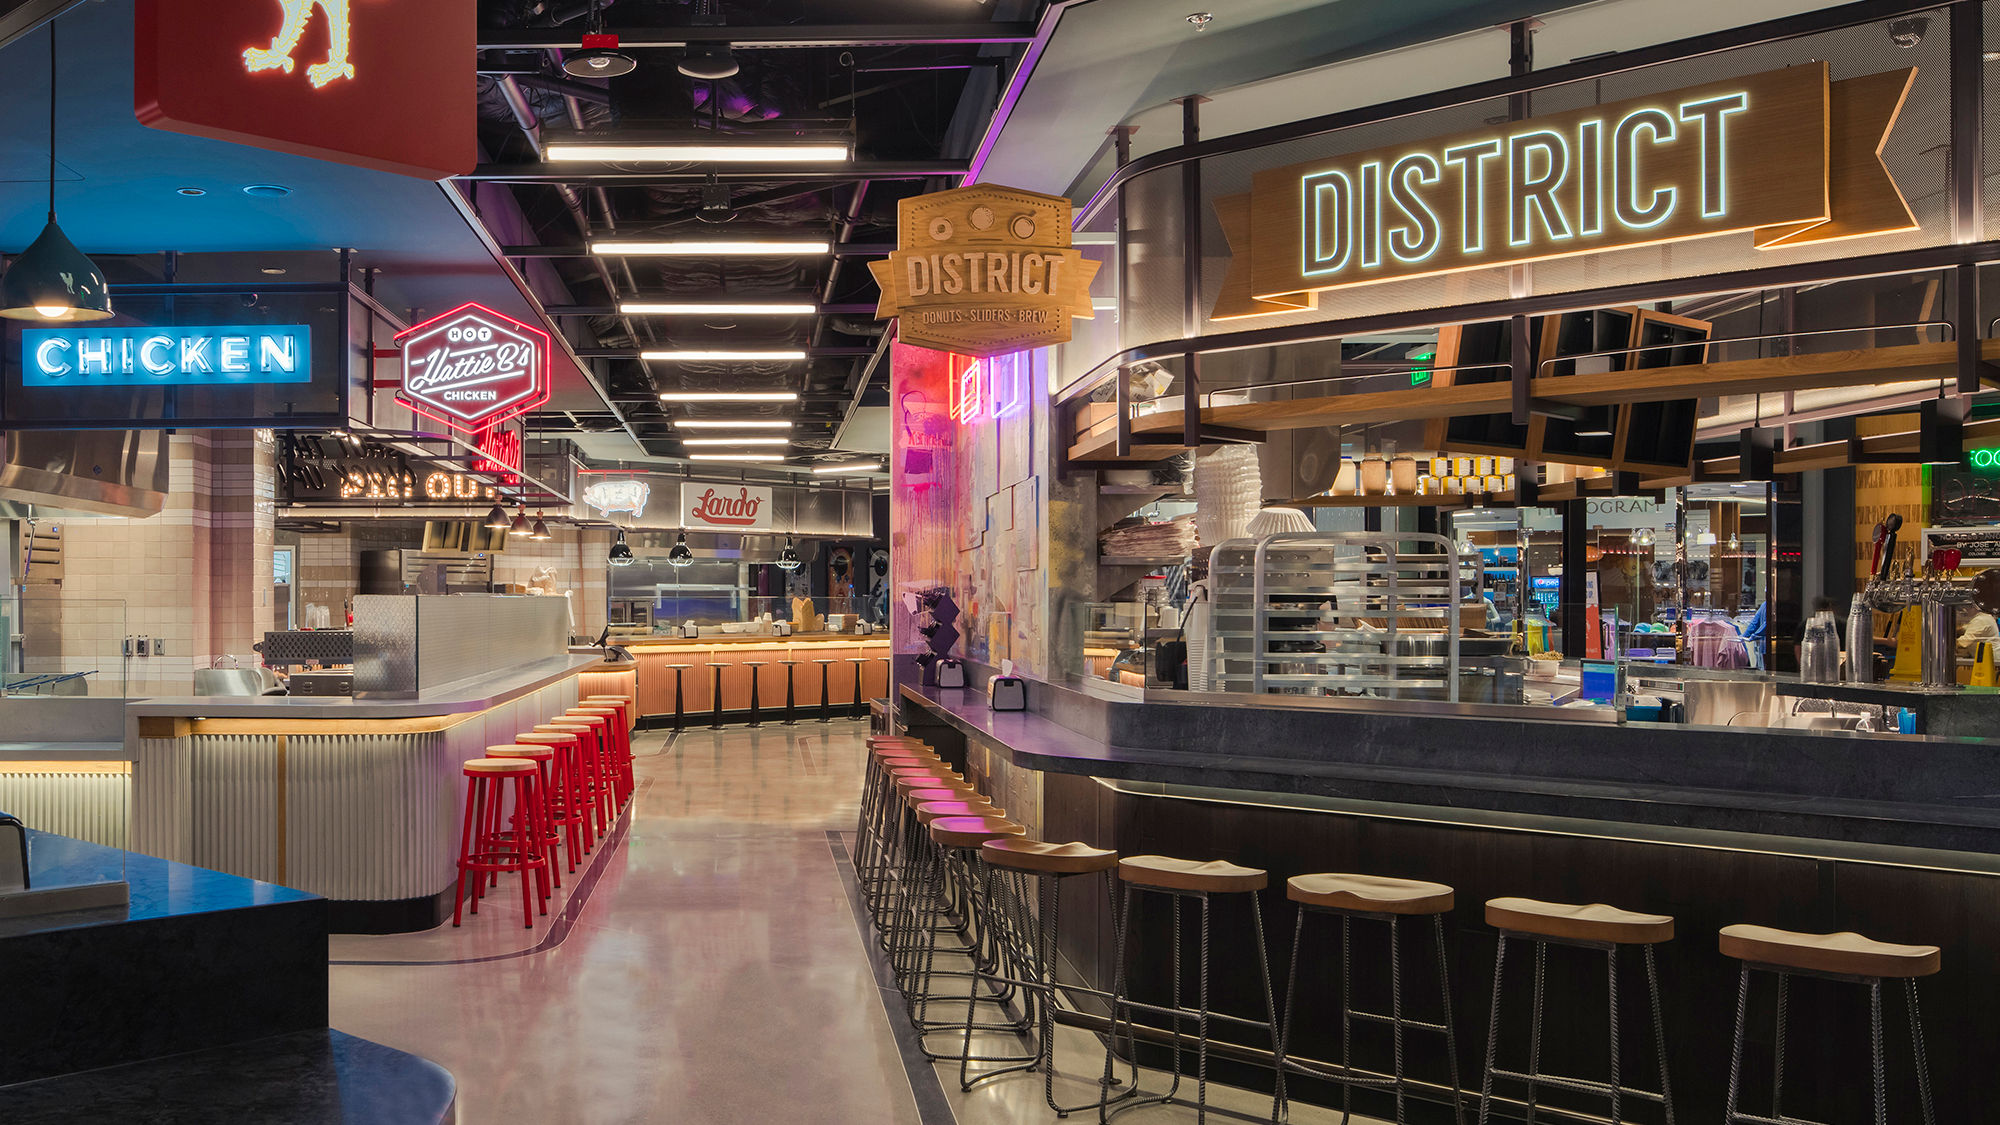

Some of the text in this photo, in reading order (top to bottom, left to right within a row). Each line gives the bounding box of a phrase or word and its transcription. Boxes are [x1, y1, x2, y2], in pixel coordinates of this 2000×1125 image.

[1301, 90, 1749, 278] DISTRICT
[906, 252, 1065, 297] DISTRICT
[450, 329, 490, 339] HOT
[922, 309, 1049, 325] DONUTS SLIDERS BREW
[36, 334, 296, 377] CHICKEN
[409, 343, 531, 391] Hattie B's
[443, 391, 497, 401] CHICKEN
[691, 487, 766, 524] Lardo
